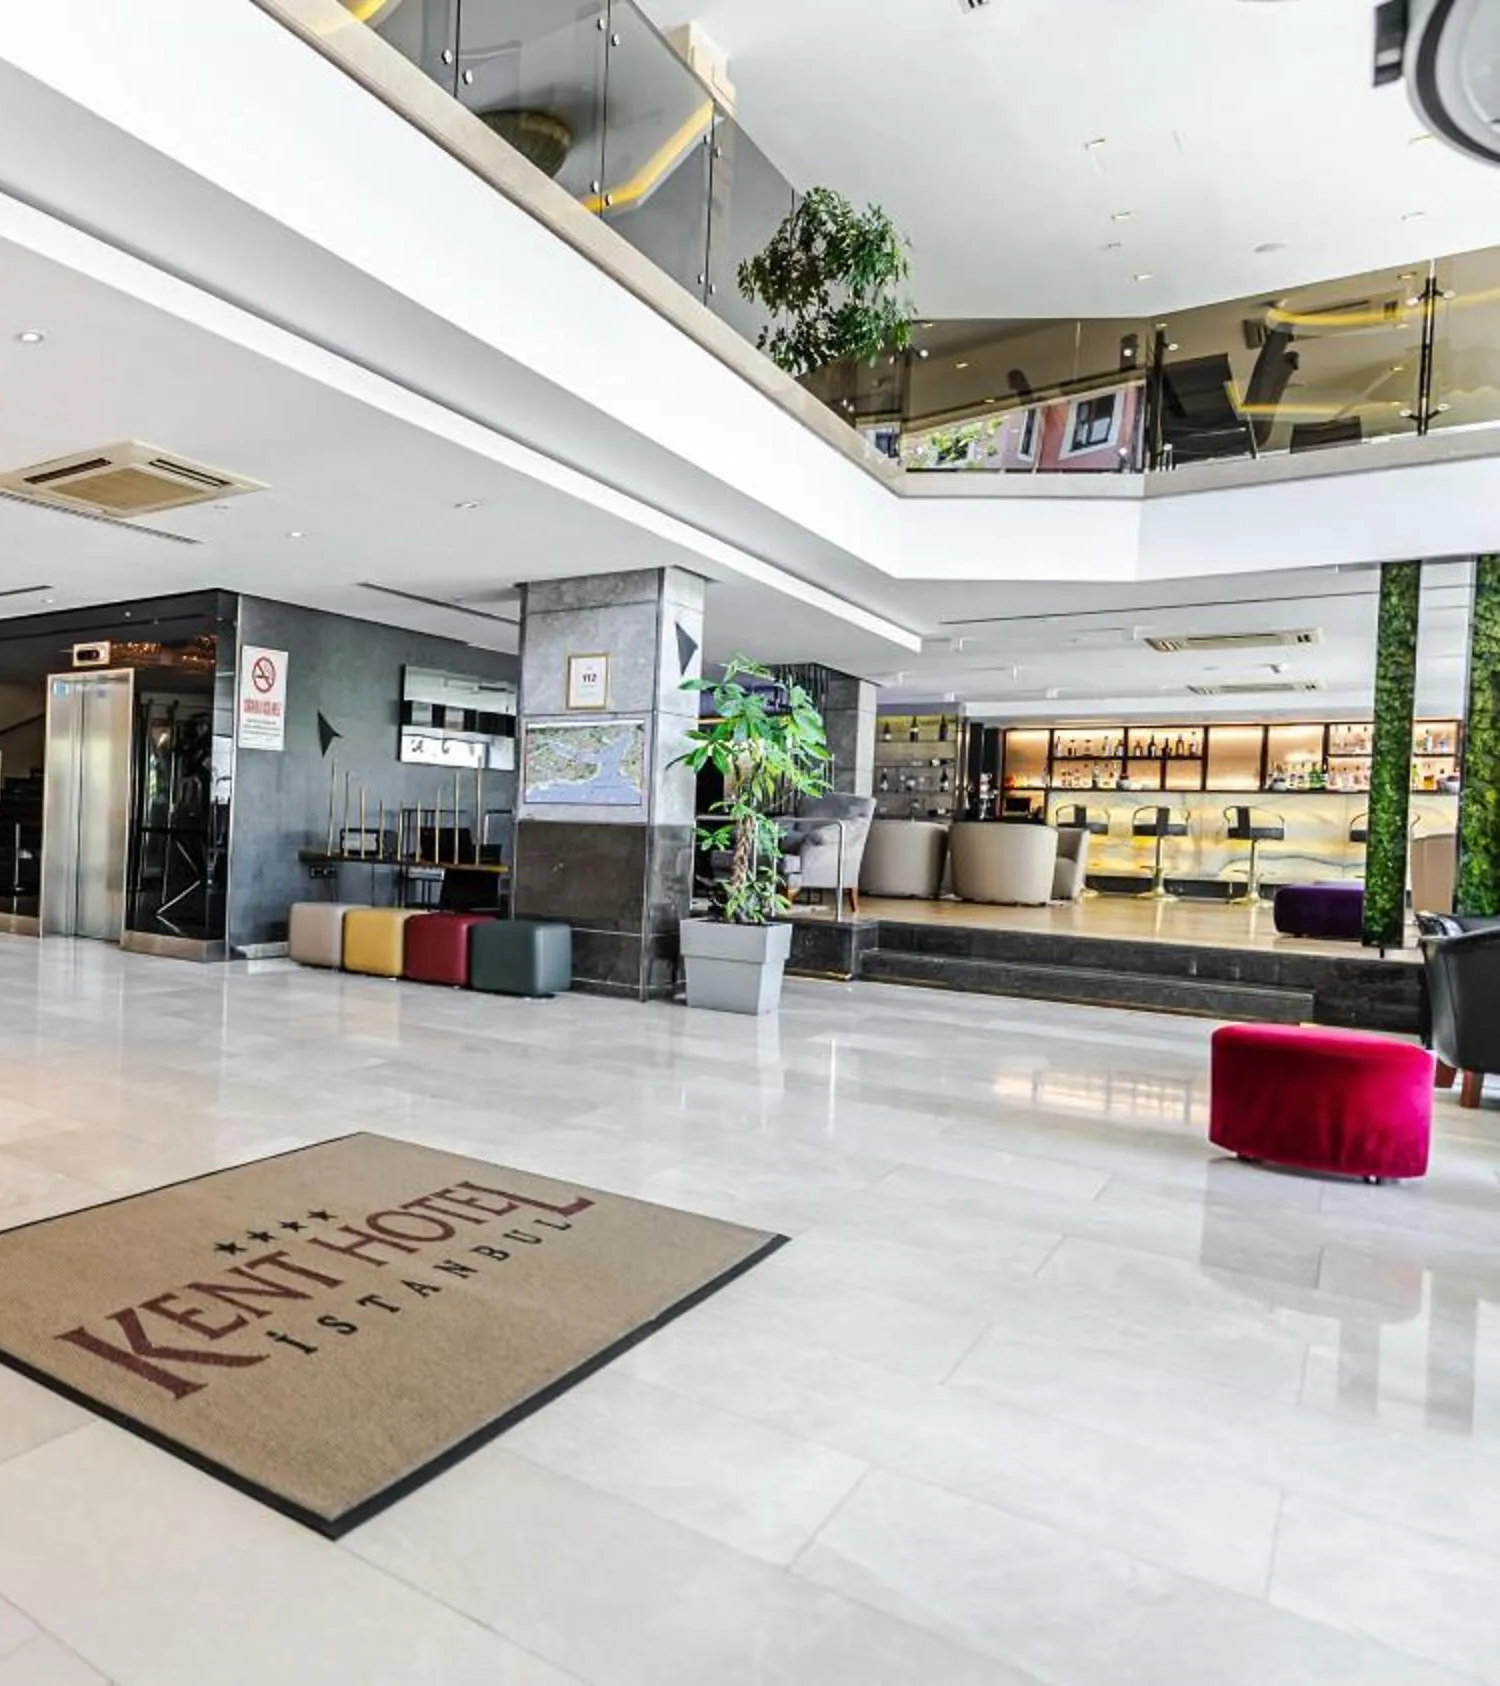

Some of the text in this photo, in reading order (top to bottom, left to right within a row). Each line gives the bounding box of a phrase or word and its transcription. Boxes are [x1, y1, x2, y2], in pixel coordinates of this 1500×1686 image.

[582, 674, 597, 682] 112
[54, 1180, 596, 1401] KENT HOTEL
